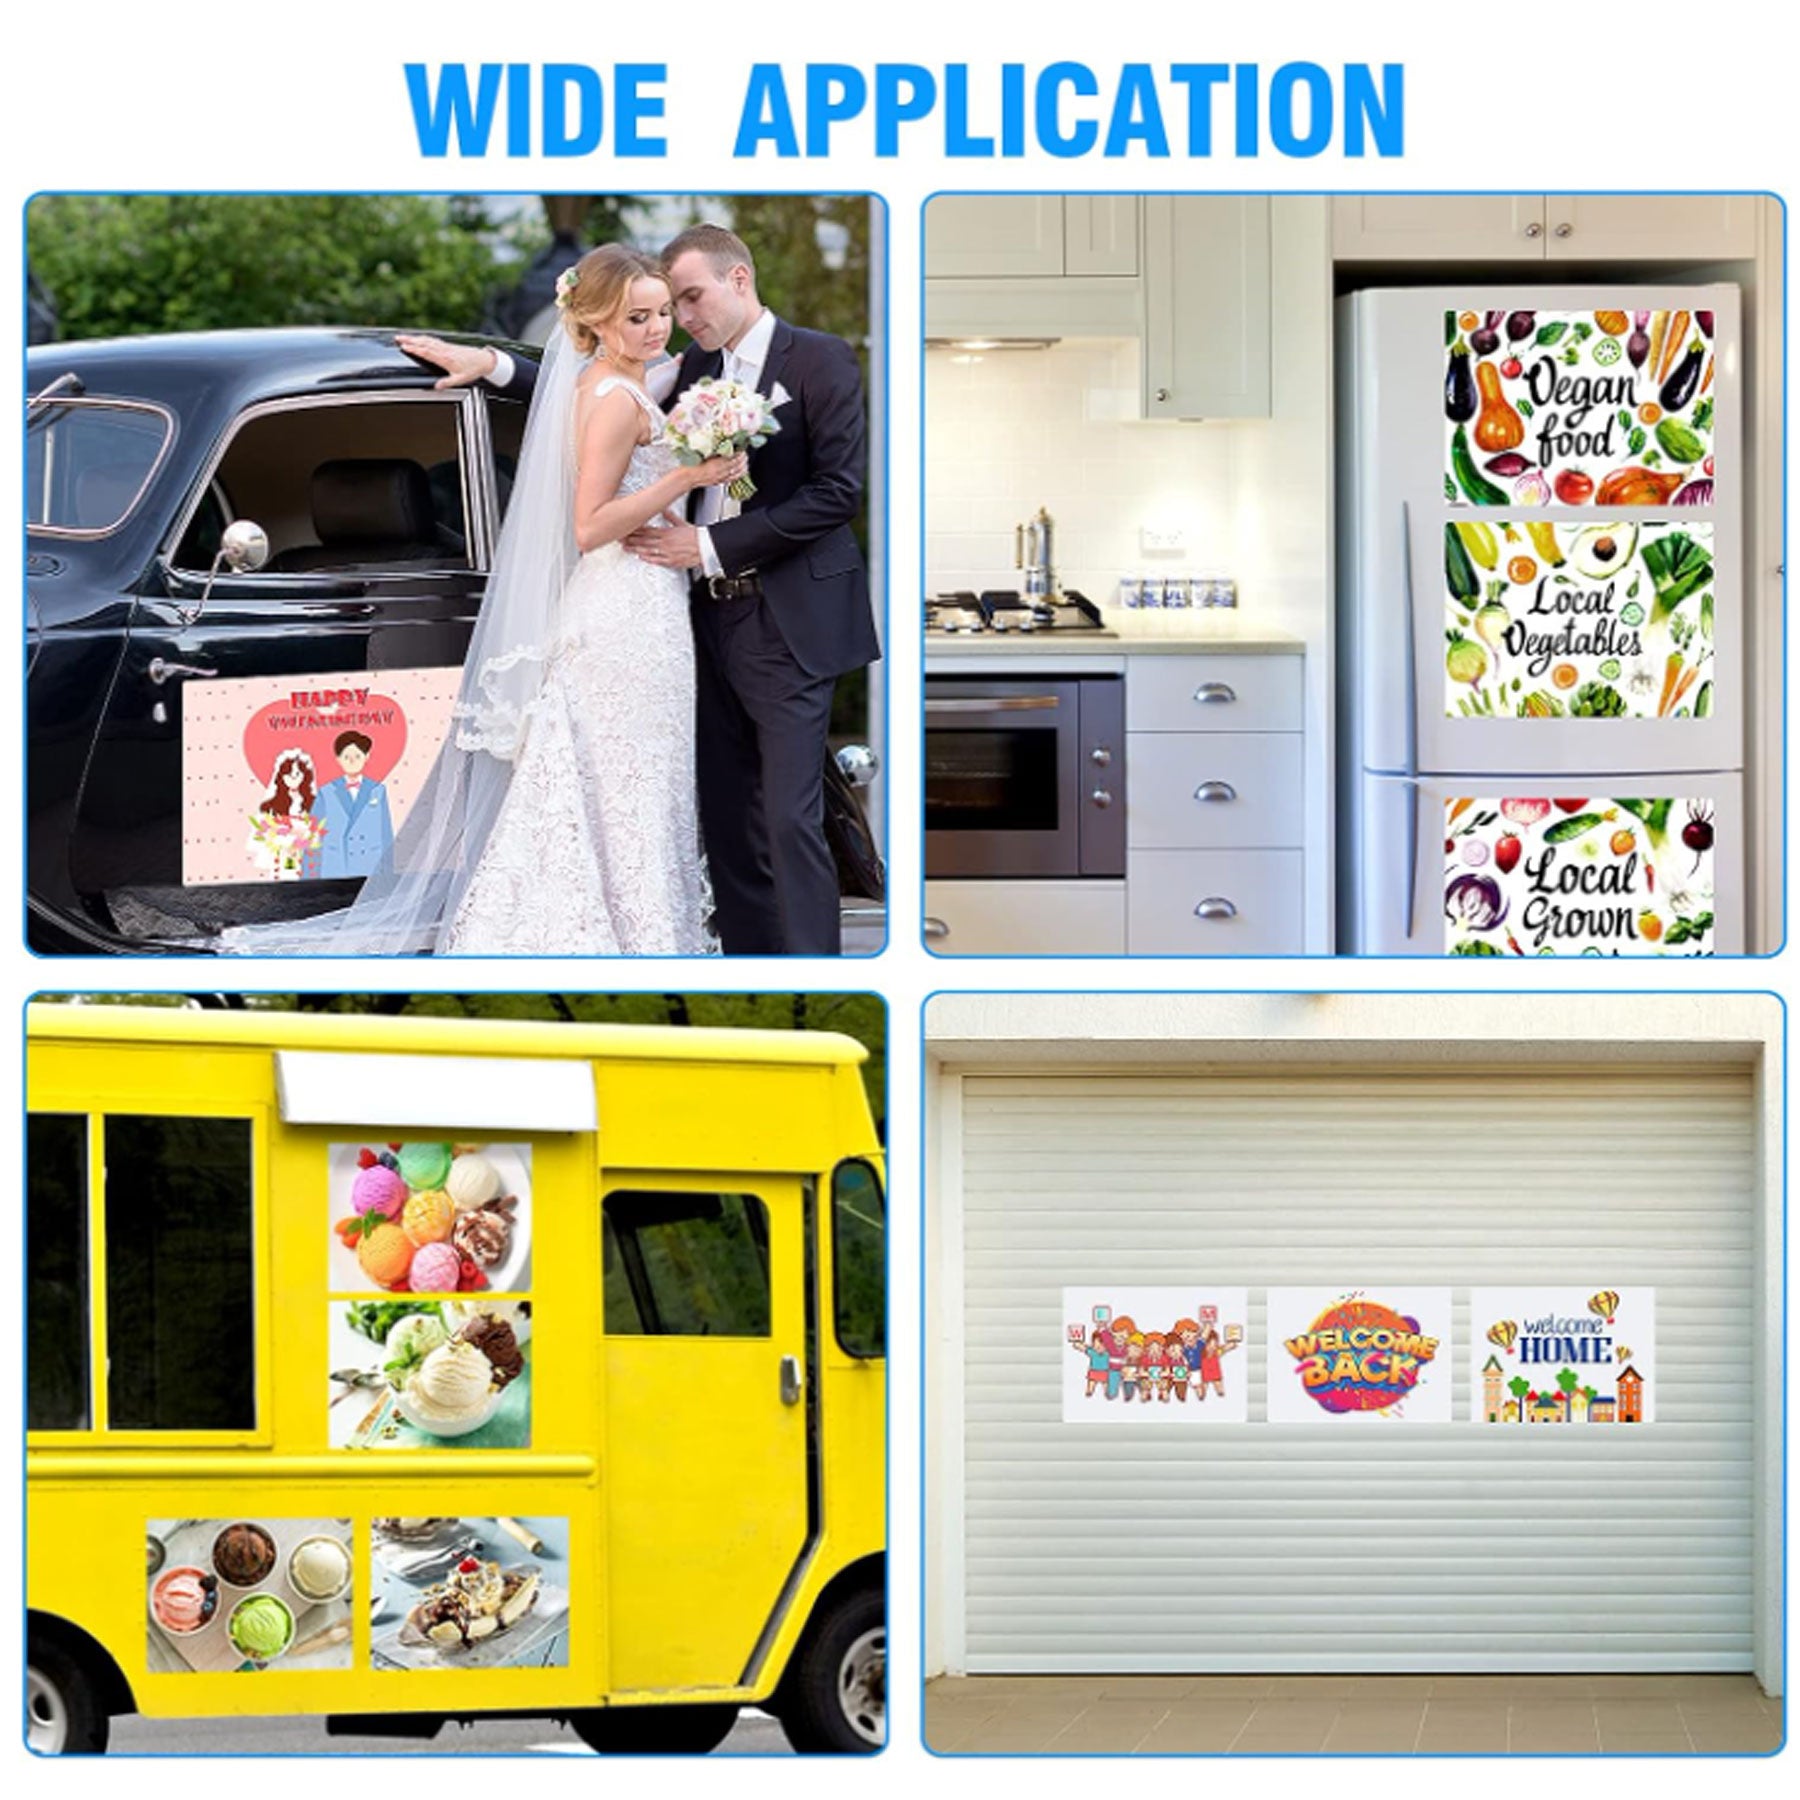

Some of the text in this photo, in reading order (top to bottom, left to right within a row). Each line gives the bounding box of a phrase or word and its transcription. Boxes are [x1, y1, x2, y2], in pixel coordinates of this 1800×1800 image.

[1522, 355, 1639, 429] Vegan
[1536, 412, 1615, 468] food
[1527, 575, 1615, 615] Local
[1500, 617, 1642, 677] Vegetables
[1524, 846, 1638, 895] Local
[1522, 896, 1638, 947] Grown
[1284, 1327, 1440, 1362] WELCOME
[1523, 1313, 1604, 1336] welcome
[1302, 1352, 1419, 1388] BACK
[1519, 1336, 1613, 1364] HOME
